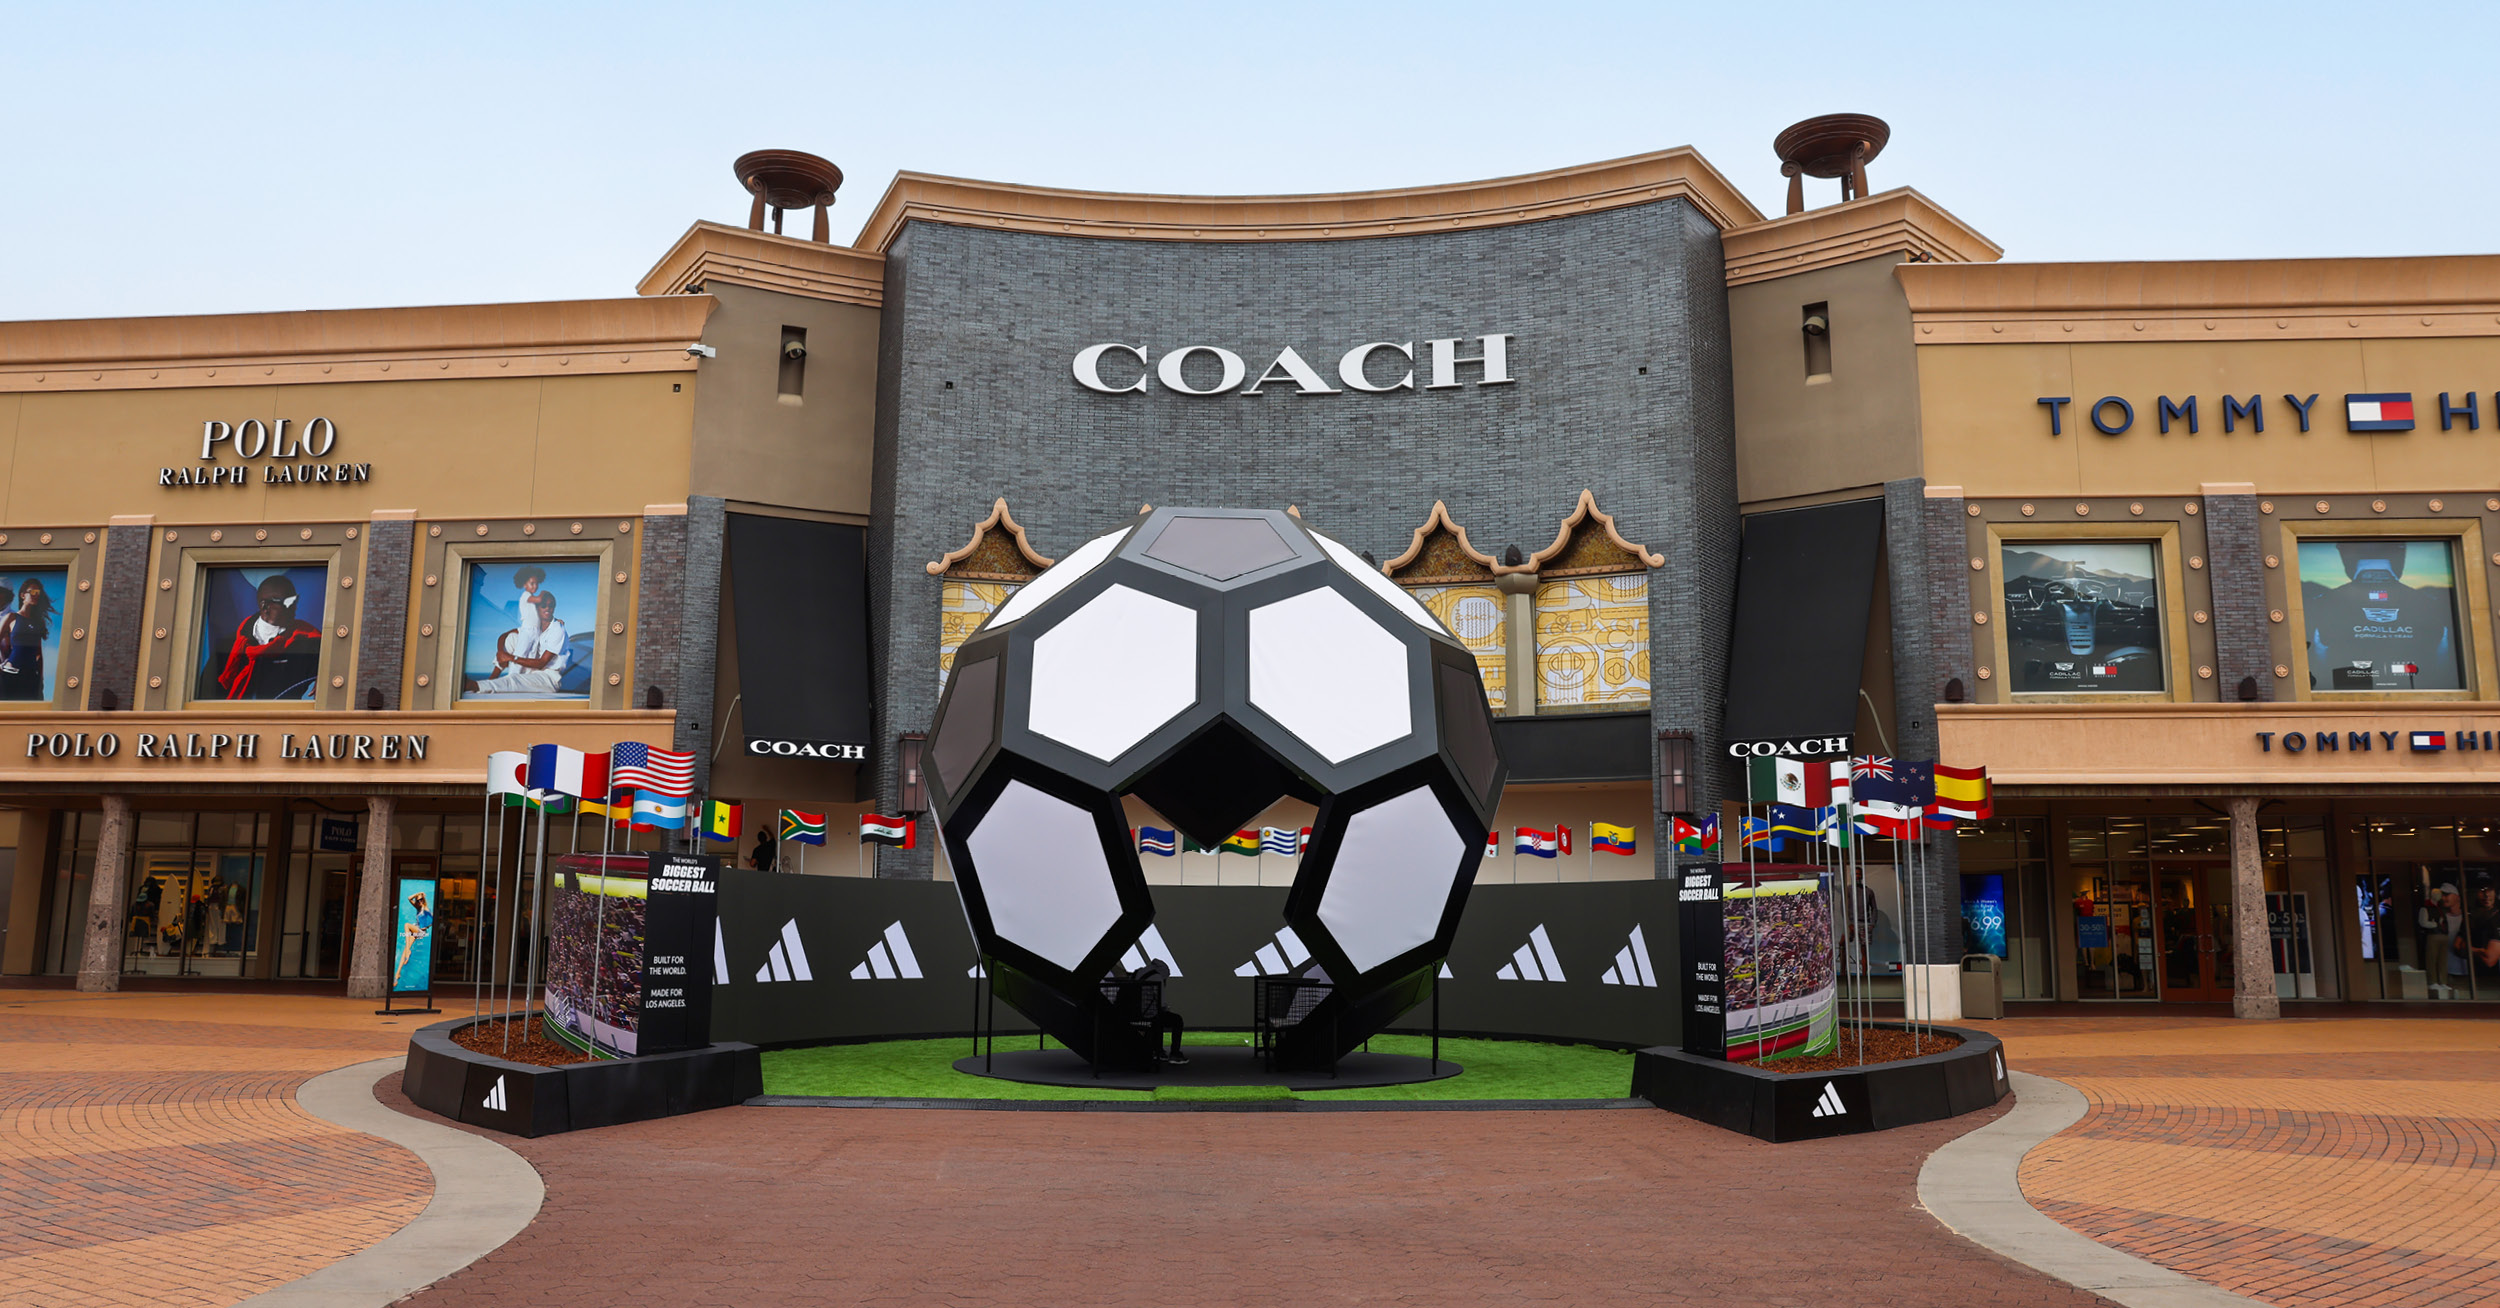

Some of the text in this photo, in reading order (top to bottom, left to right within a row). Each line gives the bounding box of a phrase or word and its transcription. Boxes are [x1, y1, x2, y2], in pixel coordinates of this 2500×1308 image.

[1072, 333, 1515, 395] COACH
[2037, 391, 2500, 436] TOMMY H
[199, 416, 337, 461] POLO
[159, 462, 372, 486] RALPH LAUREN
[2353, 625, 2413, 633] CADILLAC
[25, 732, 430, 760] POLO RALPH LAUREN
[1729, 737, 1848, 757] COACH
[2256, 730, 2399, 752] TOMMY
[749, 740, 866, 759] COACH
[662, 864, 706, 879] BIGGEST
[651, 878, 715, 894] SOCCER BALL
[1685, 875, 1712, 888] BIGGEST
[1679, 888, 1719, 901] SOCCER BALL
[653, 956, 684, 964] BUILT FOR
[1698, 962, 1717, 971] BUILT FOR
[649, 967, 687, 975] THE WORLD.
[651, 988, 683, 997] MADE FOR
[645, 999, 686, 1009] LOS ANGELES.
